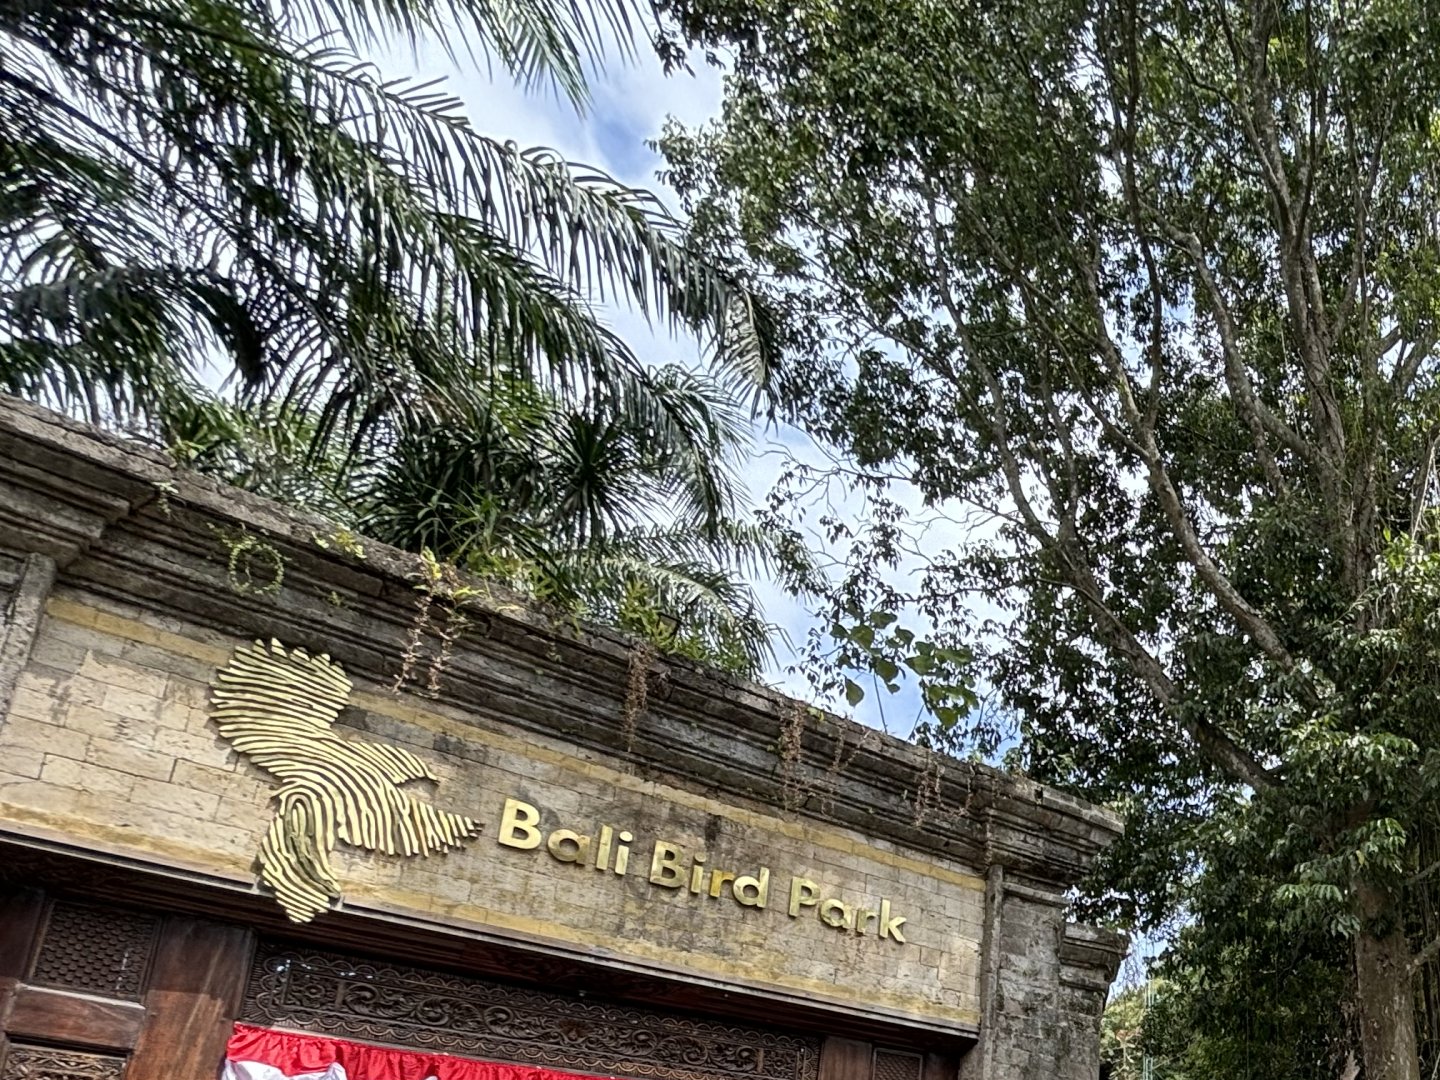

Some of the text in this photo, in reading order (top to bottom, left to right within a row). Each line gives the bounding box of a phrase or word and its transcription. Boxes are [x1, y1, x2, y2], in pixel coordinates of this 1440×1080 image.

[497, 798, 906, 943] Bali Bird Park
